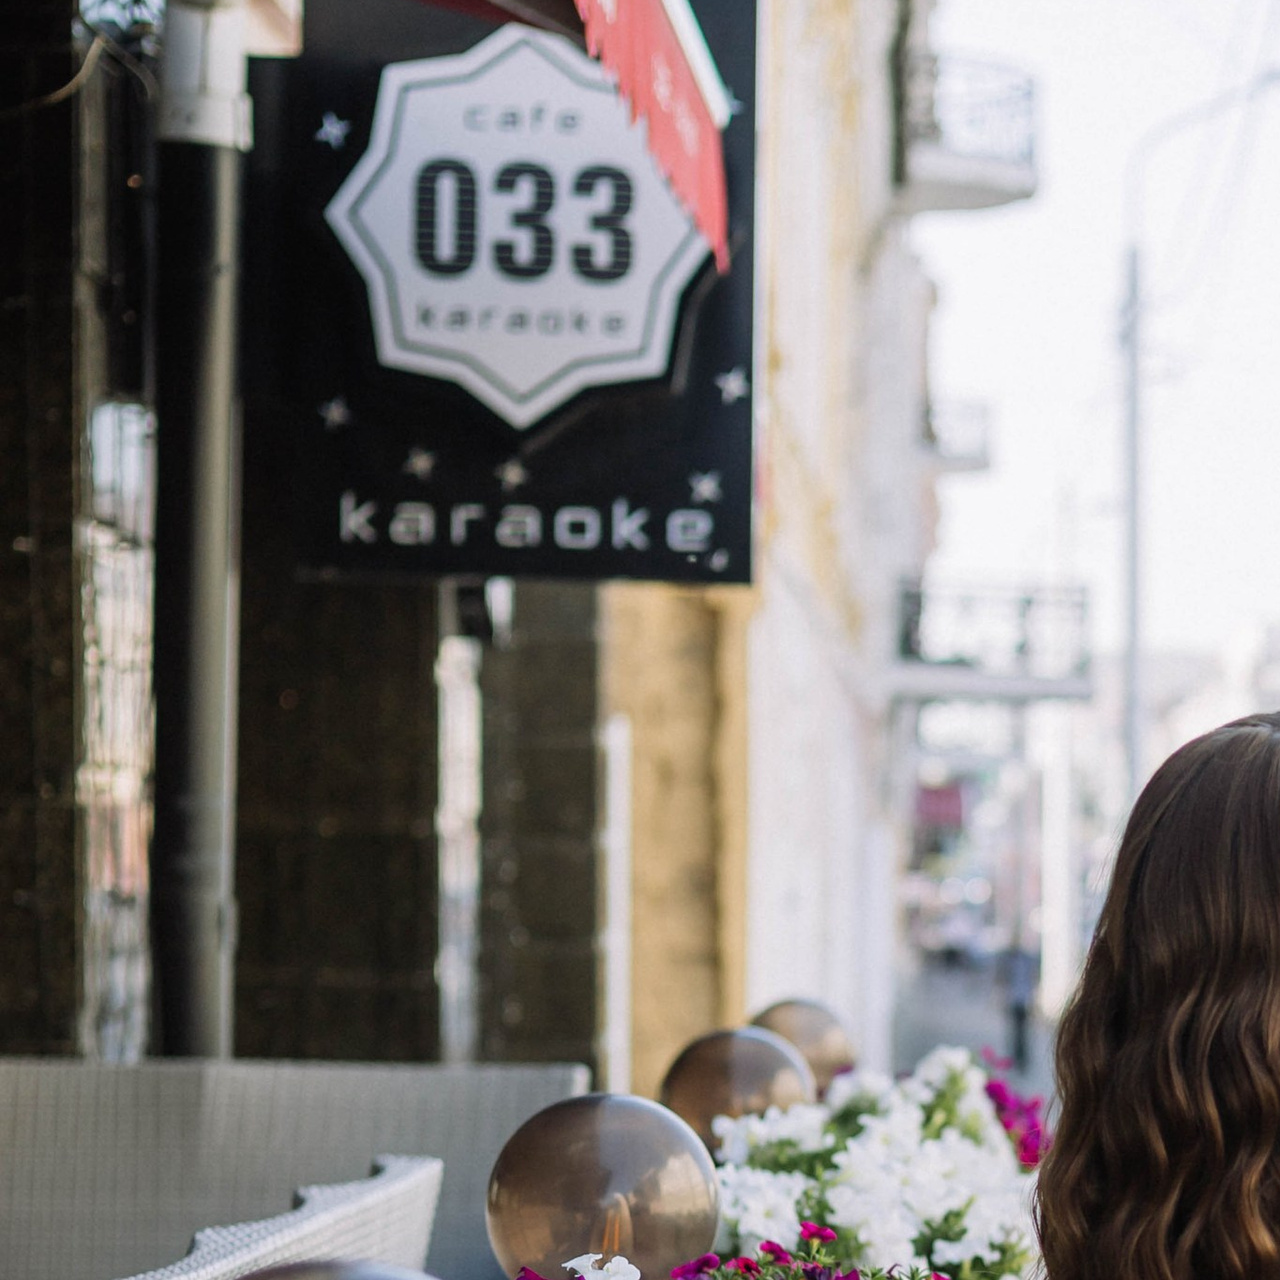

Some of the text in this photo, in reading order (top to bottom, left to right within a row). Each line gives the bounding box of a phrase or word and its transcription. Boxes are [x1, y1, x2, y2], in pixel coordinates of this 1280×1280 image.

[463, 103, 582, 133] cafe
[415, 159, 632, 282] 033
[415, 302, 627, 337] karaoke
[339, 492, 714, 552] karaoke
